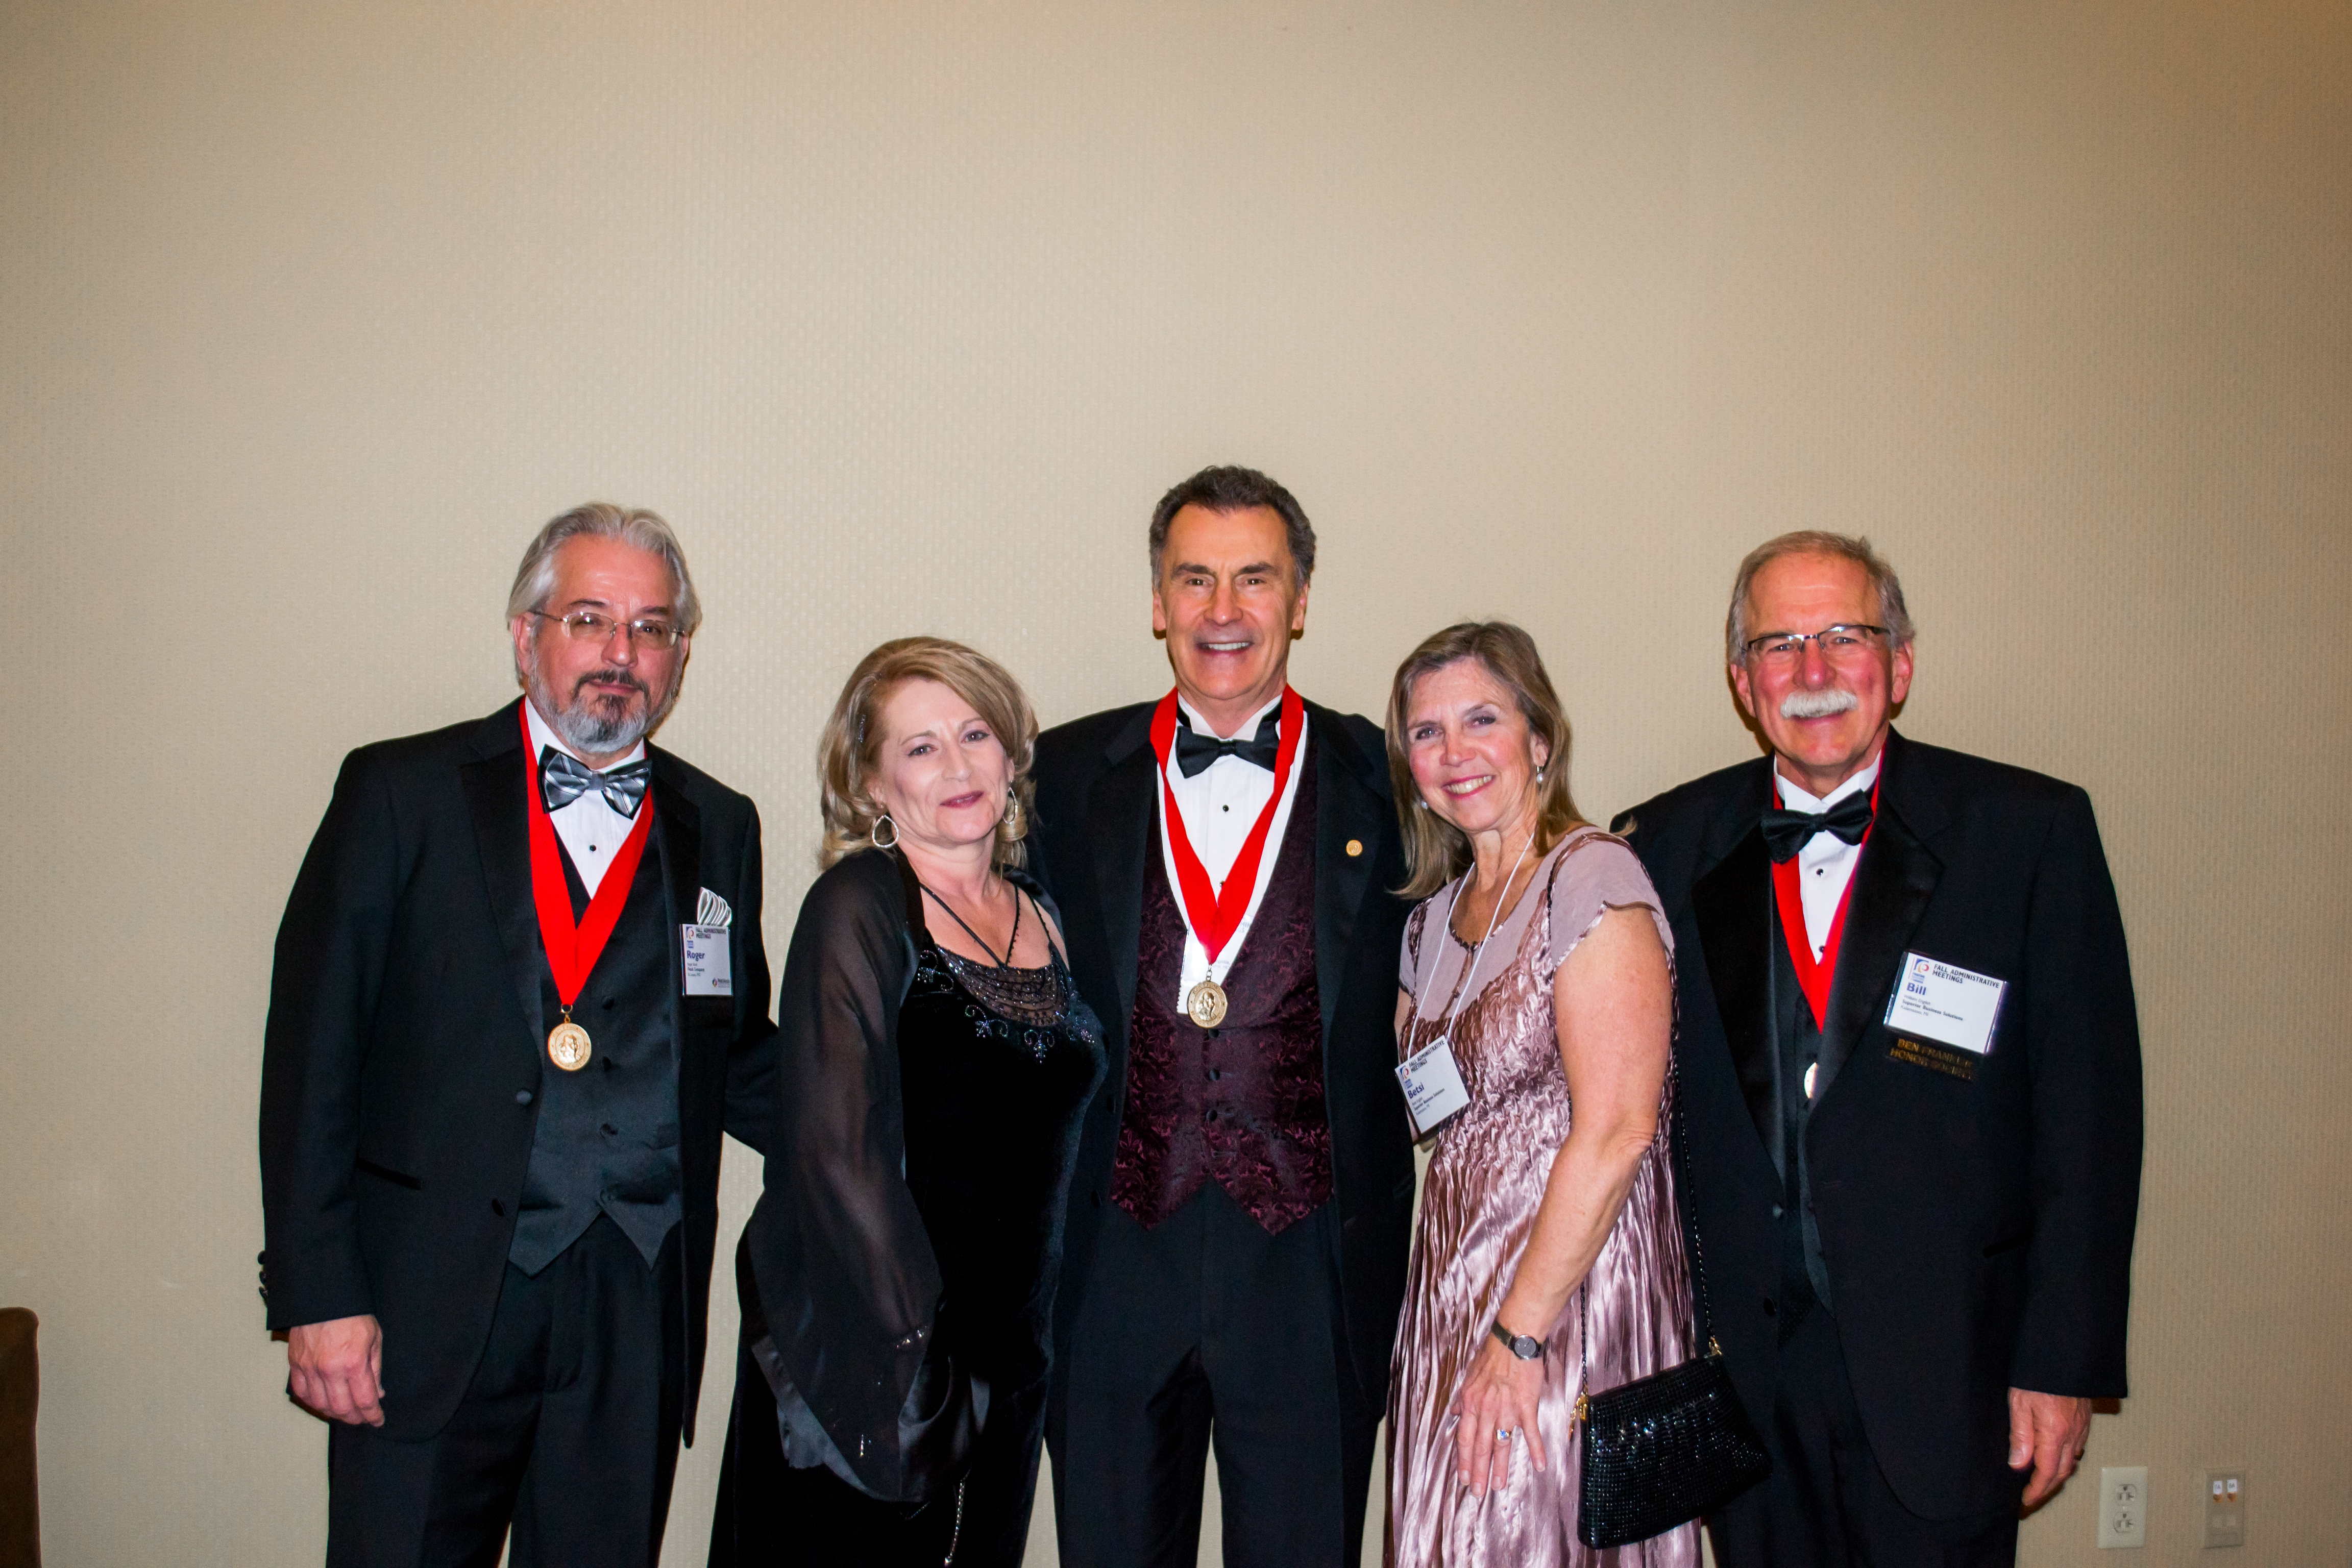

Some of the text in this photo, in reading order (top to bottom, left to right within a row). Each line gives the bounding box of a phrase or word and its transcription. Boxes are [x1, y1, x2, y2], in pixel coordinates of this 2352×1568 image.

[687, 950, 705, 962] Roger
[1932, 970, 1963, 984] MEETINGS
[1934, 964, 1999, 988] FALL ADMINISTRATIVE
[1906, 982, 1926, 995] Bill
[1902, 999, 1963, 1021] Superior Business Solutions
[1409, 1039, 1444, 1067] FALL ADMINISTRATIVE
[1411, 1058, 1427, 1072] MEETINGS
